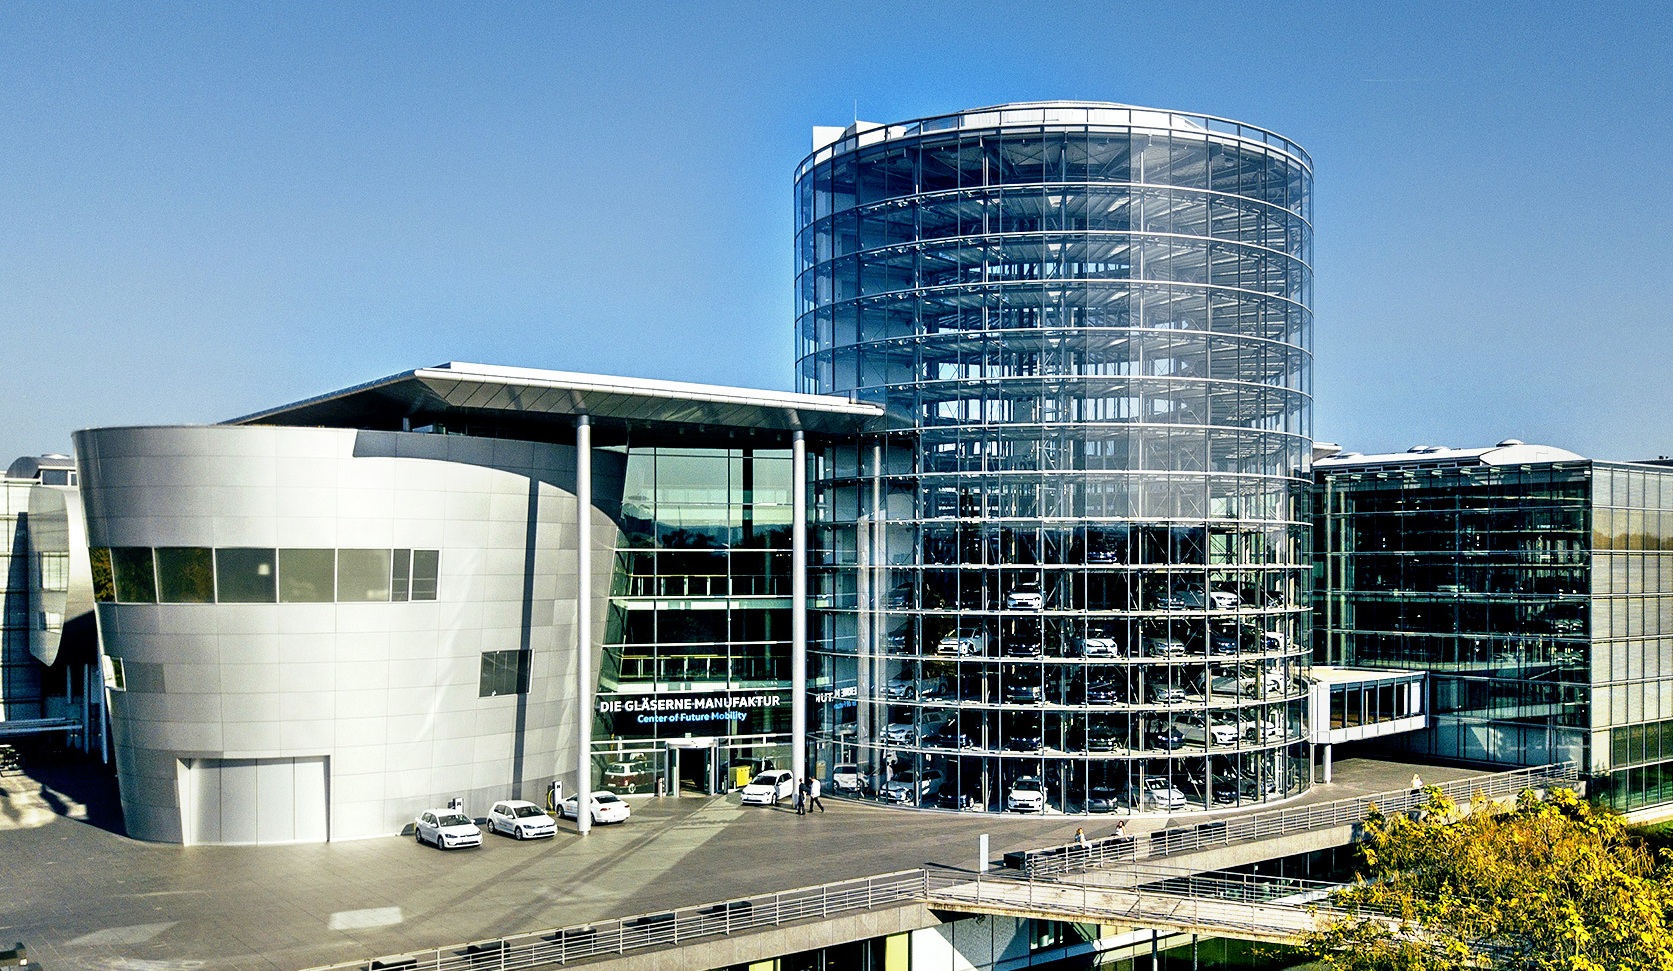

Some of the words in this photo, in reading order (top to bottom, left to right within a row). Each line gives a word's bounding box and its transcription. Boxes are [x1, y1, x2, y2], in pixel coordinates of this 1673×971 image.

[600, 700, 622, 712] DIE
[624, 696, 692, 711] GLÄSERNE
[694, 695, 780, 708] MANUFAKTUR
[637, 713, 667, 723] Center
[668, 713, 679, 723] of
[680, 711, 709, 722] Future
[711, 710, 747, 721] Mobility
